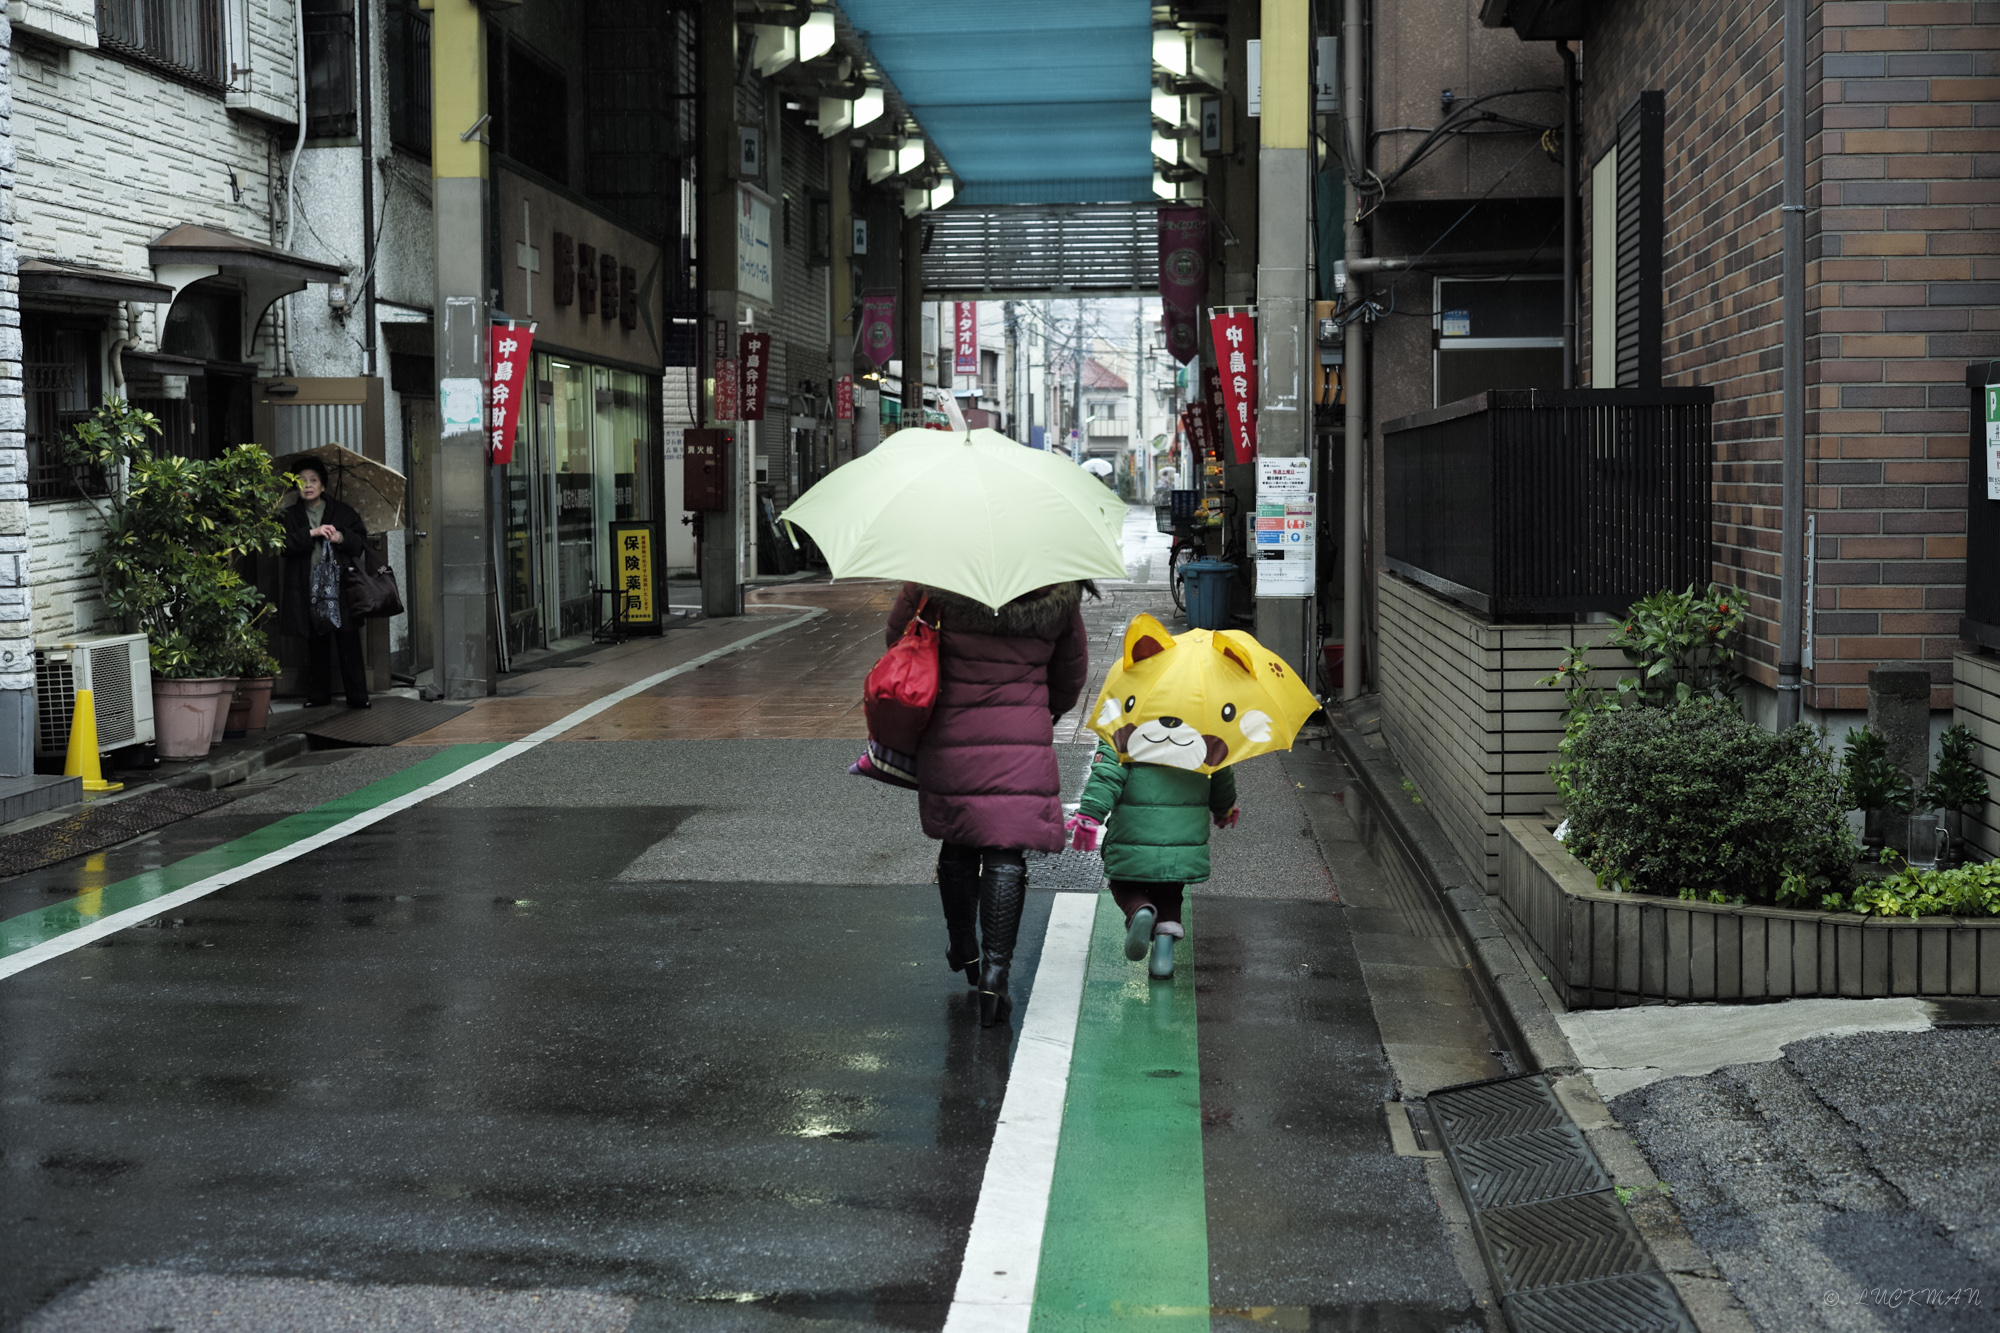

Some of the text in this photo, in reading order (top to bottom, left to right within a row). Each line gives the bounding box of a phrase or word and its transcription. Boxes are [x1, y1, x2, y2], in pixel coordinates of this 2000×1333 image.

[492, 338, 518, 450] 中島弁財天
[745, 340, 761, 412] 中島弁財天
[688, 445, 714, 454] 消火栓
[624, 536, 641, 610] 保険薬局
